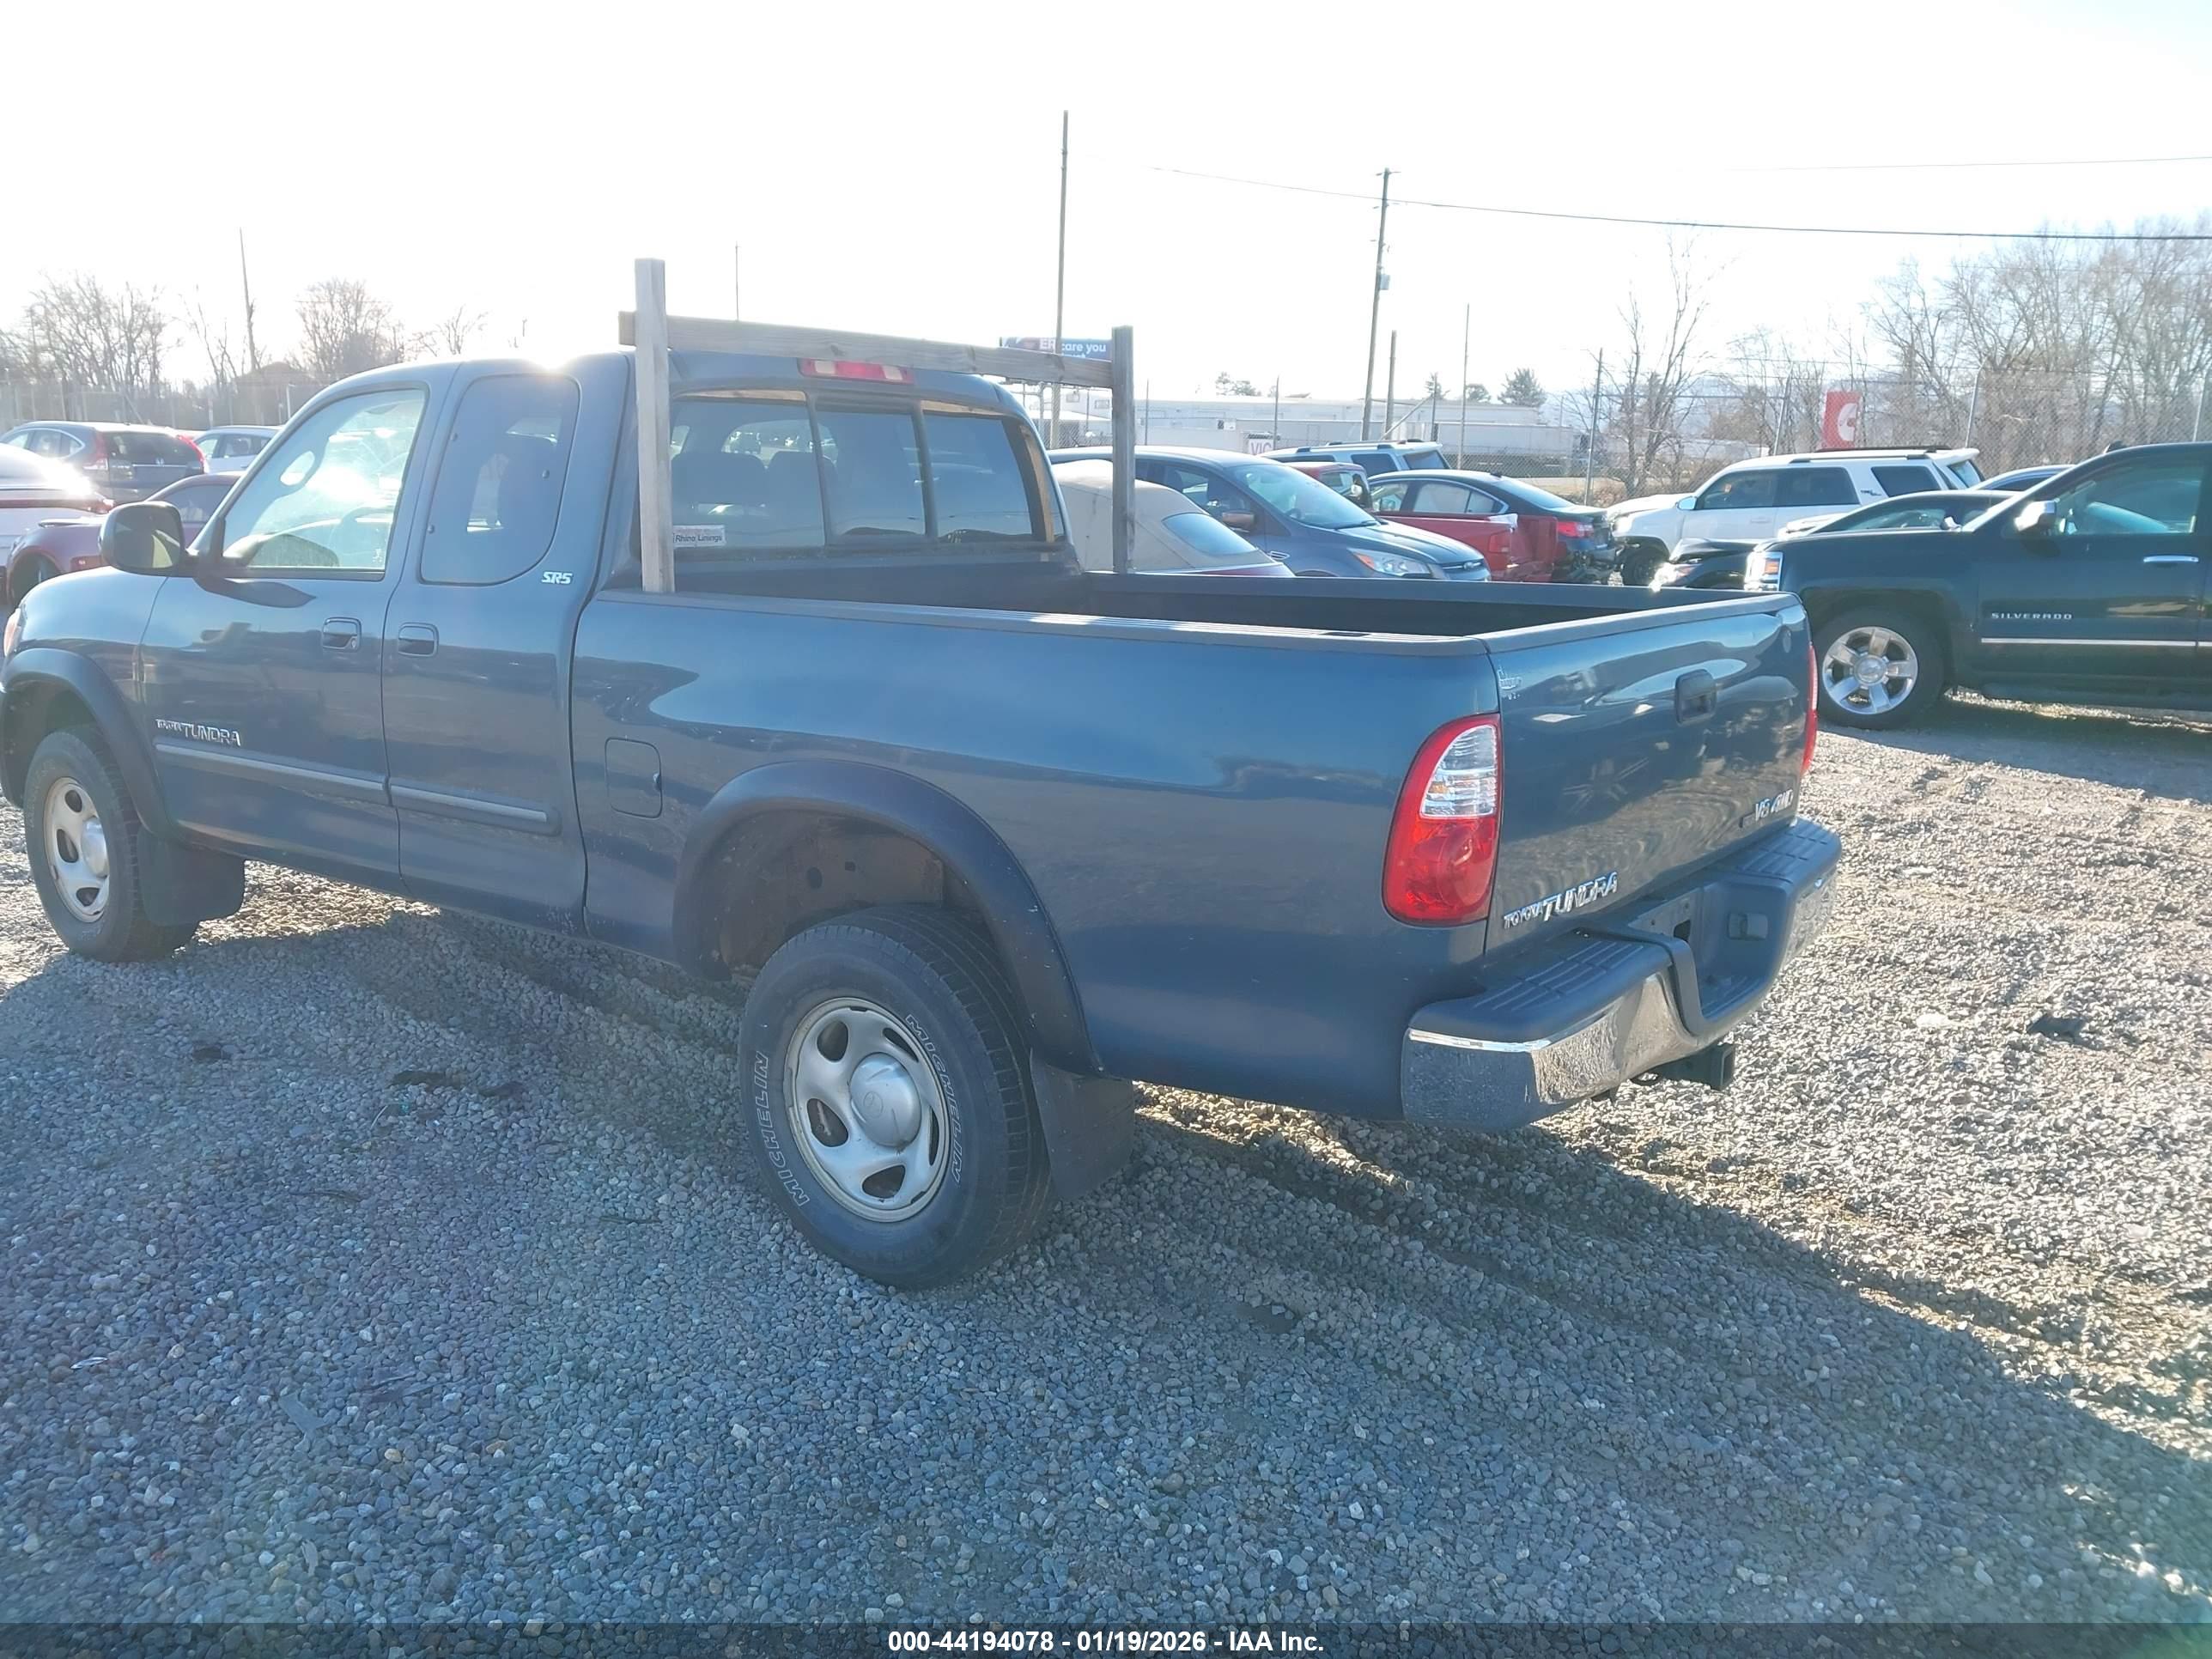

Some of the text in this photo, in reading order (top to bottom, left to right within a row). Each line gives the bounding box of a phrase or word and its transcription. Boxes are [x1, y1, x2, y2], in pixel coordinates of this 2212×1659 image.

[1085, 343, 1106, 354] you
[541, 571, 573, 585] SR5
[181, 722, 241, 746] TUNDRA
[1504, 871, 1618, 929] TOYOTA TUNDRA
[905, 1013, 963, 1184] MICHELIN
[754, 1050, 811, 1207] MICHELIN
